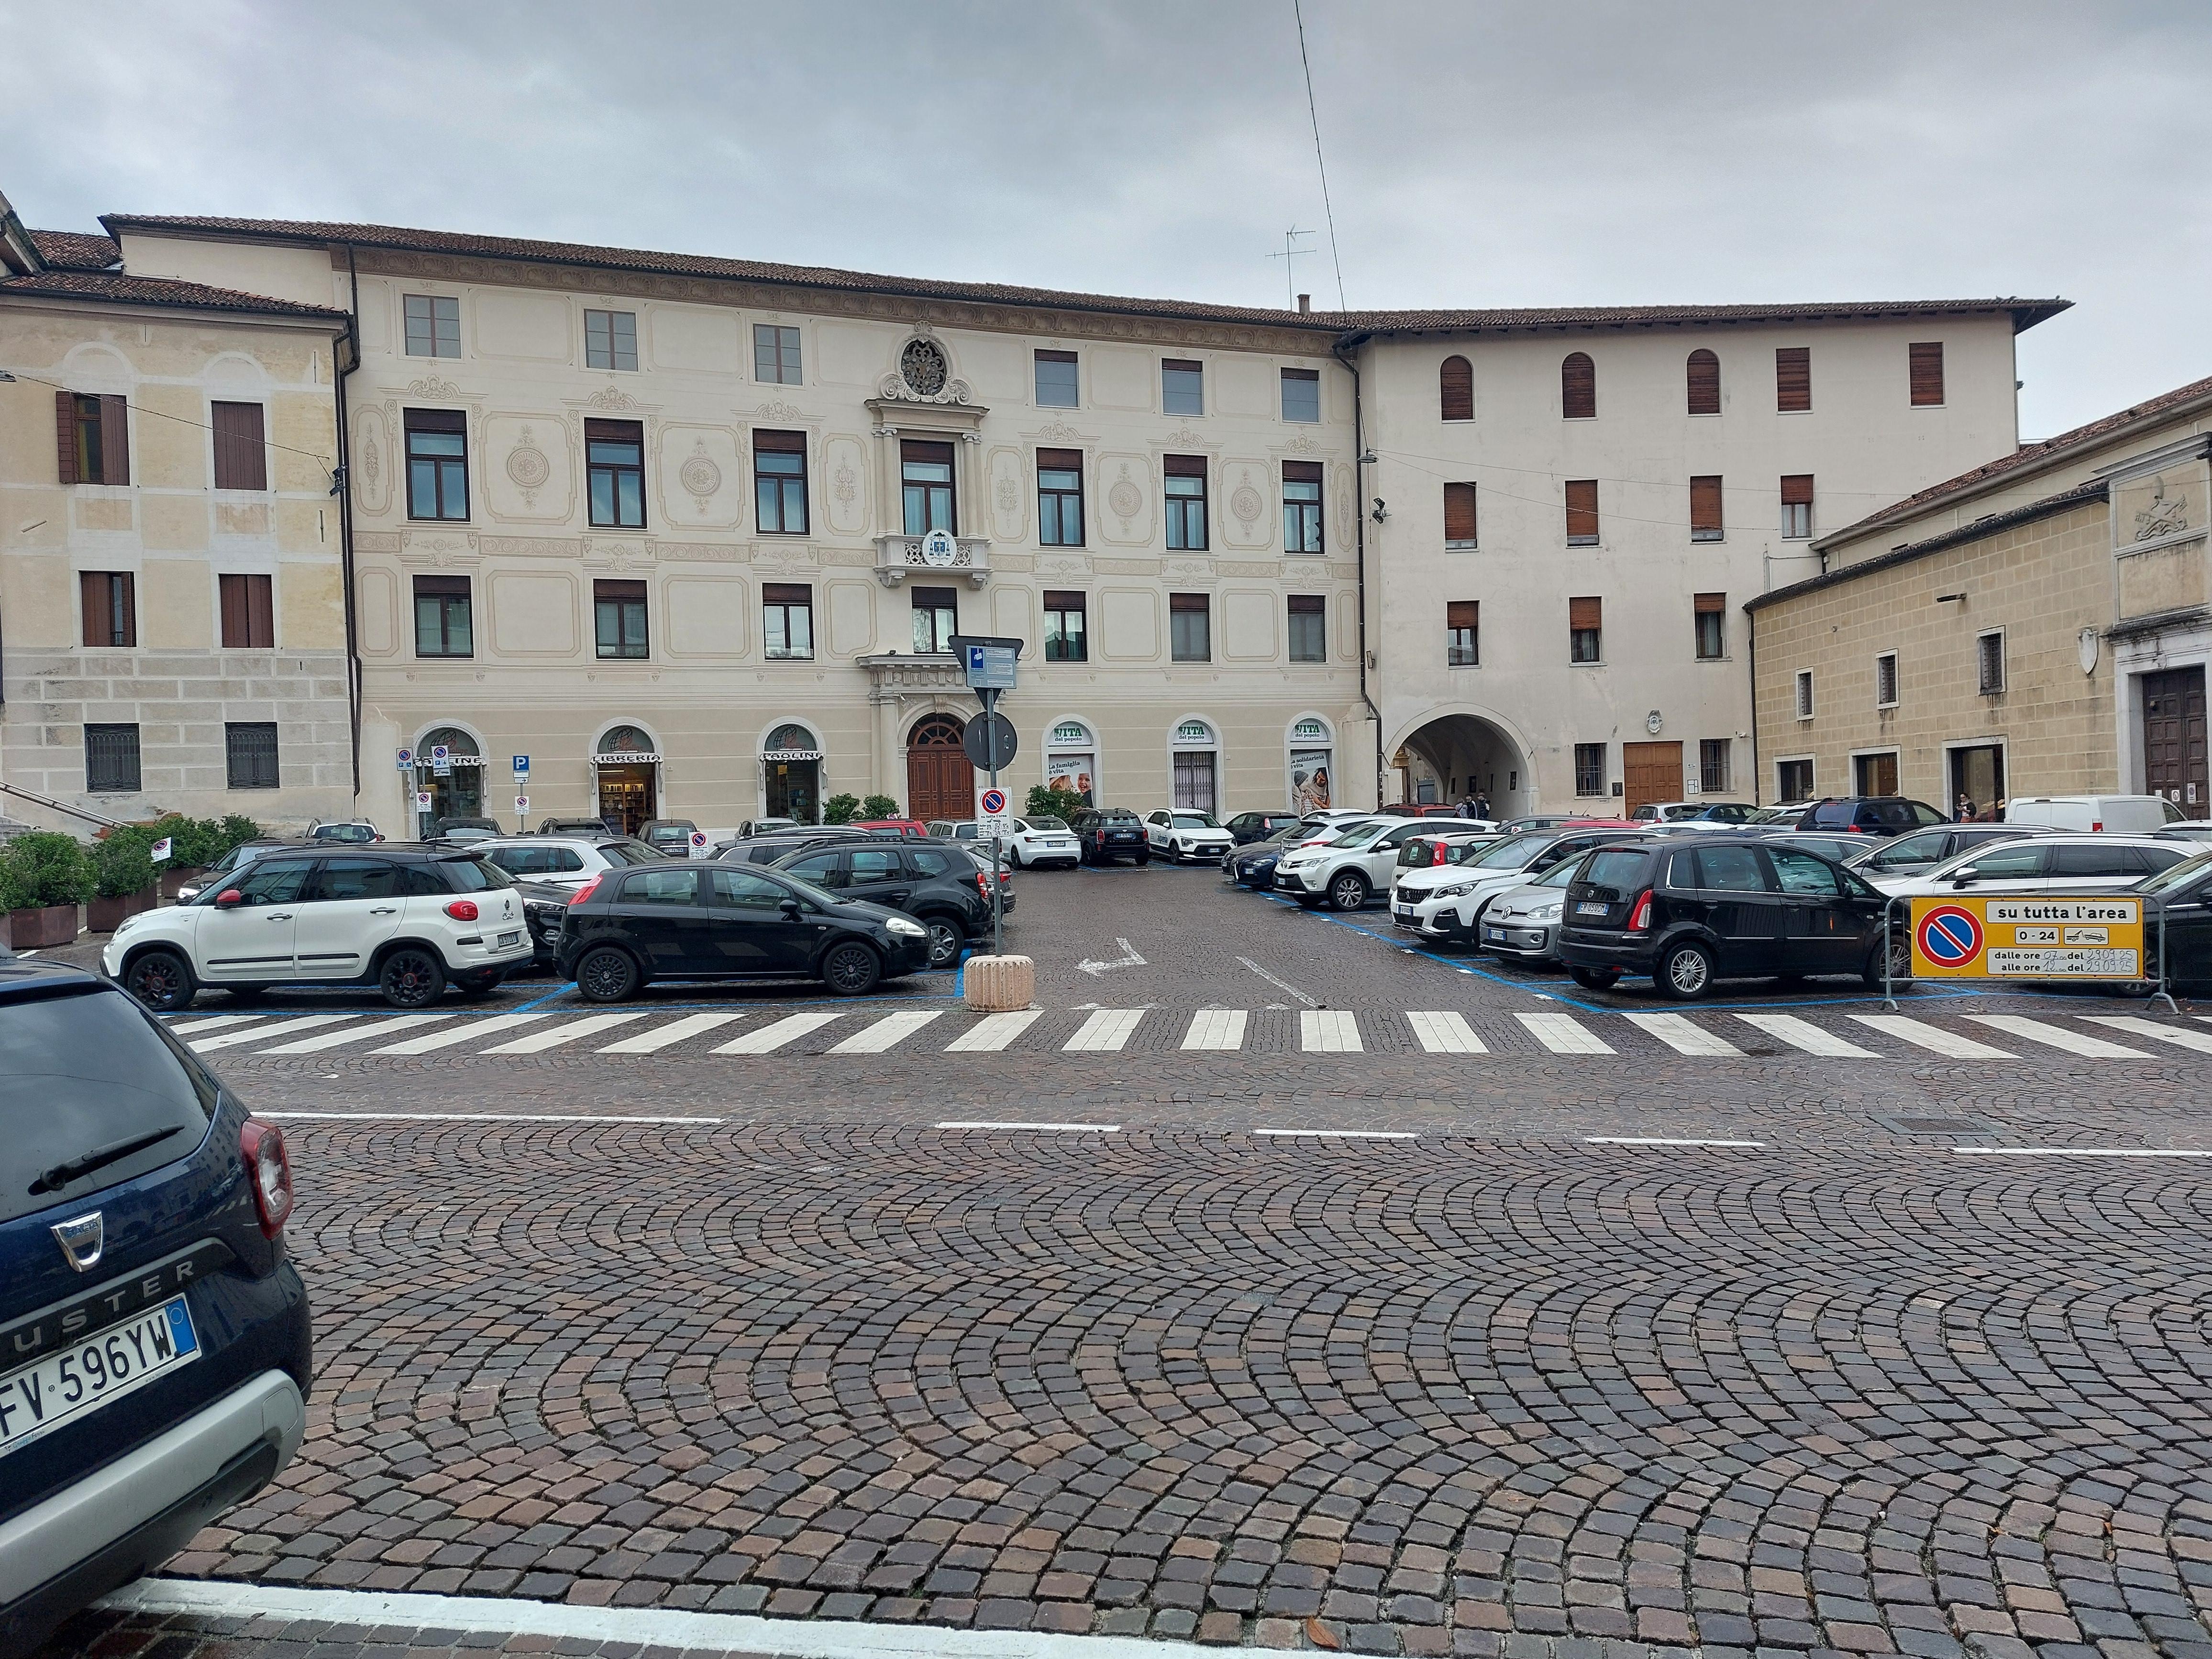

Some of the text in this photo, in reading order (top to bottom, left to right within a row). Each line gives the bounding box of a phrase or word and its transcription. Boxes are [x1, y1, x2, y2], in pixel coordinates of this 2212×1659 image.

[1054, 728, 1082, 737] VITA
[1178, 727, 1205, 735] VITA
[1295, 725, 1320, 733] VITA
[1296, 754, 1324, 763] solidarietà
[1998, 906, 2127, 919] su tutta l'area
[2019, 931, 2027, 940] 0
[2039, 931, 2055, 940] 24
